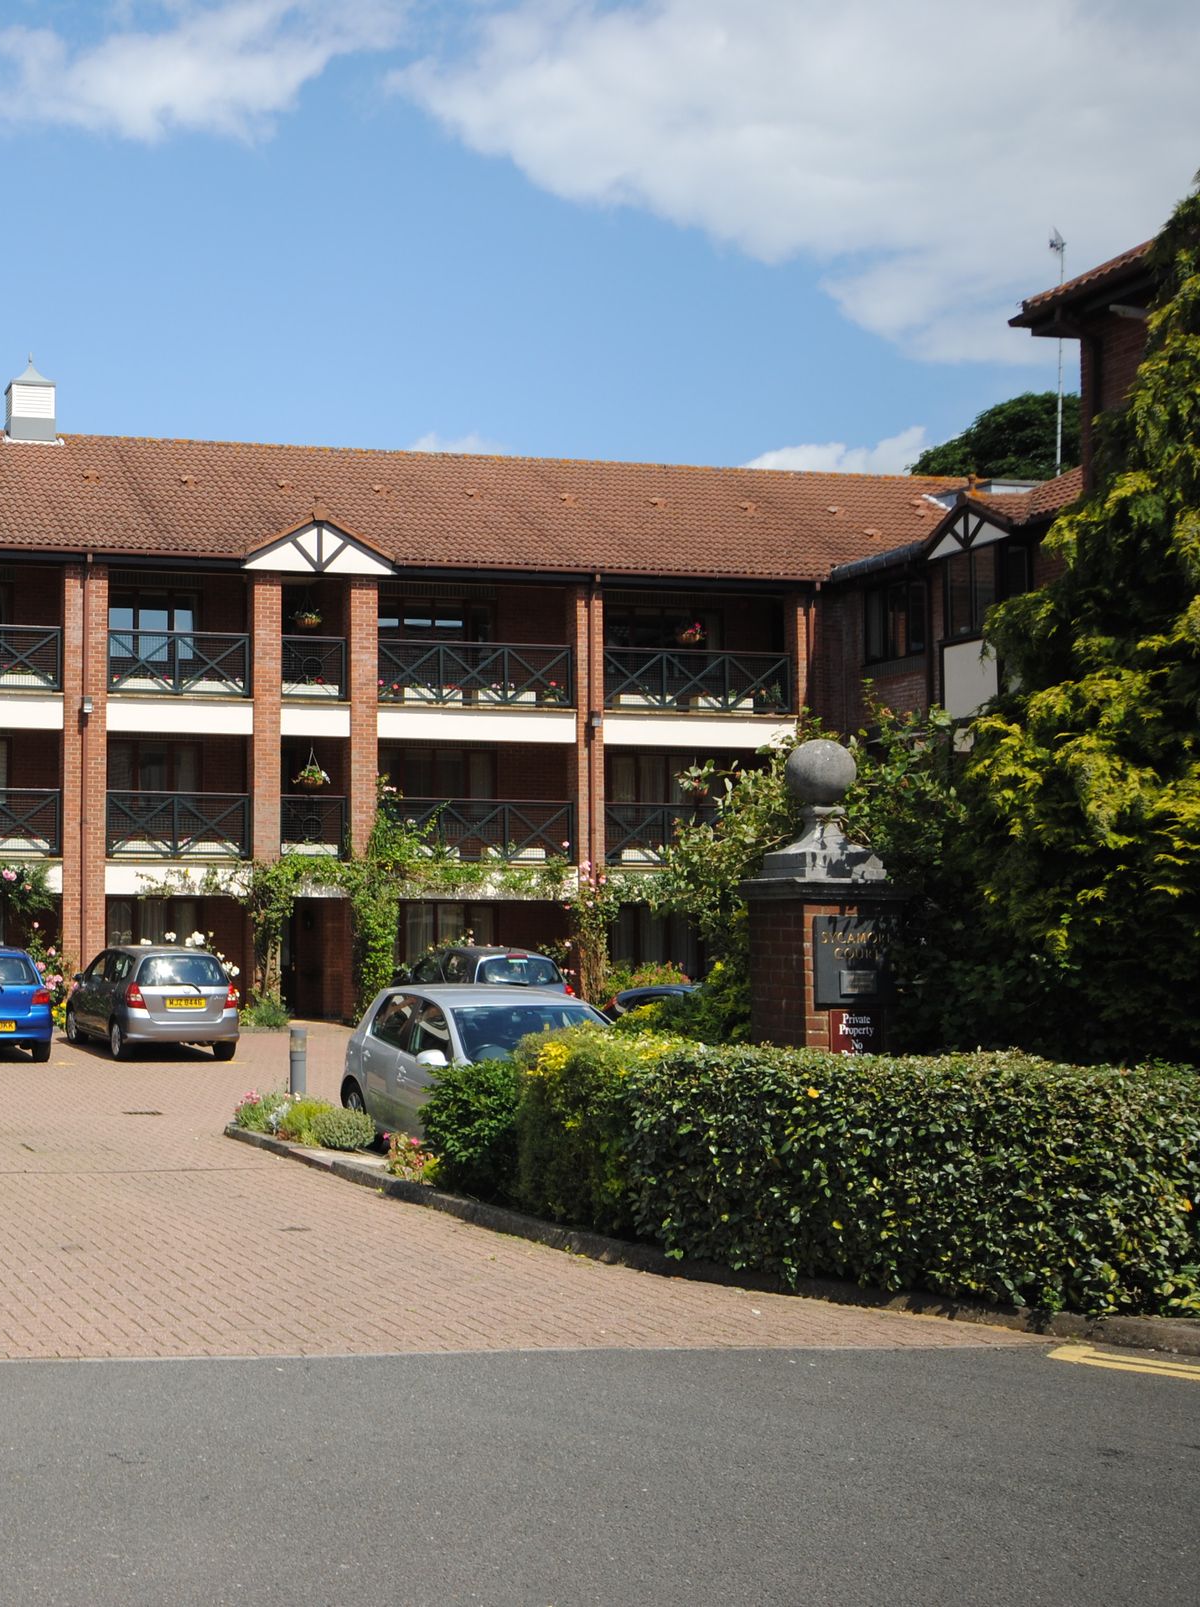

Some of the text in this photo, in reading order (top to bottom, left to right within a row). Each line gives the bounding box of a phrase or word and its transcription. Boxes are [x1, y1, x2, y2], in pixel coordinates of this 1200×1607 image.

[842, 1013, 871, 1024] Private
[839, 1024, 874, 1036] Property
[851, 1038, 864, 1050] No
